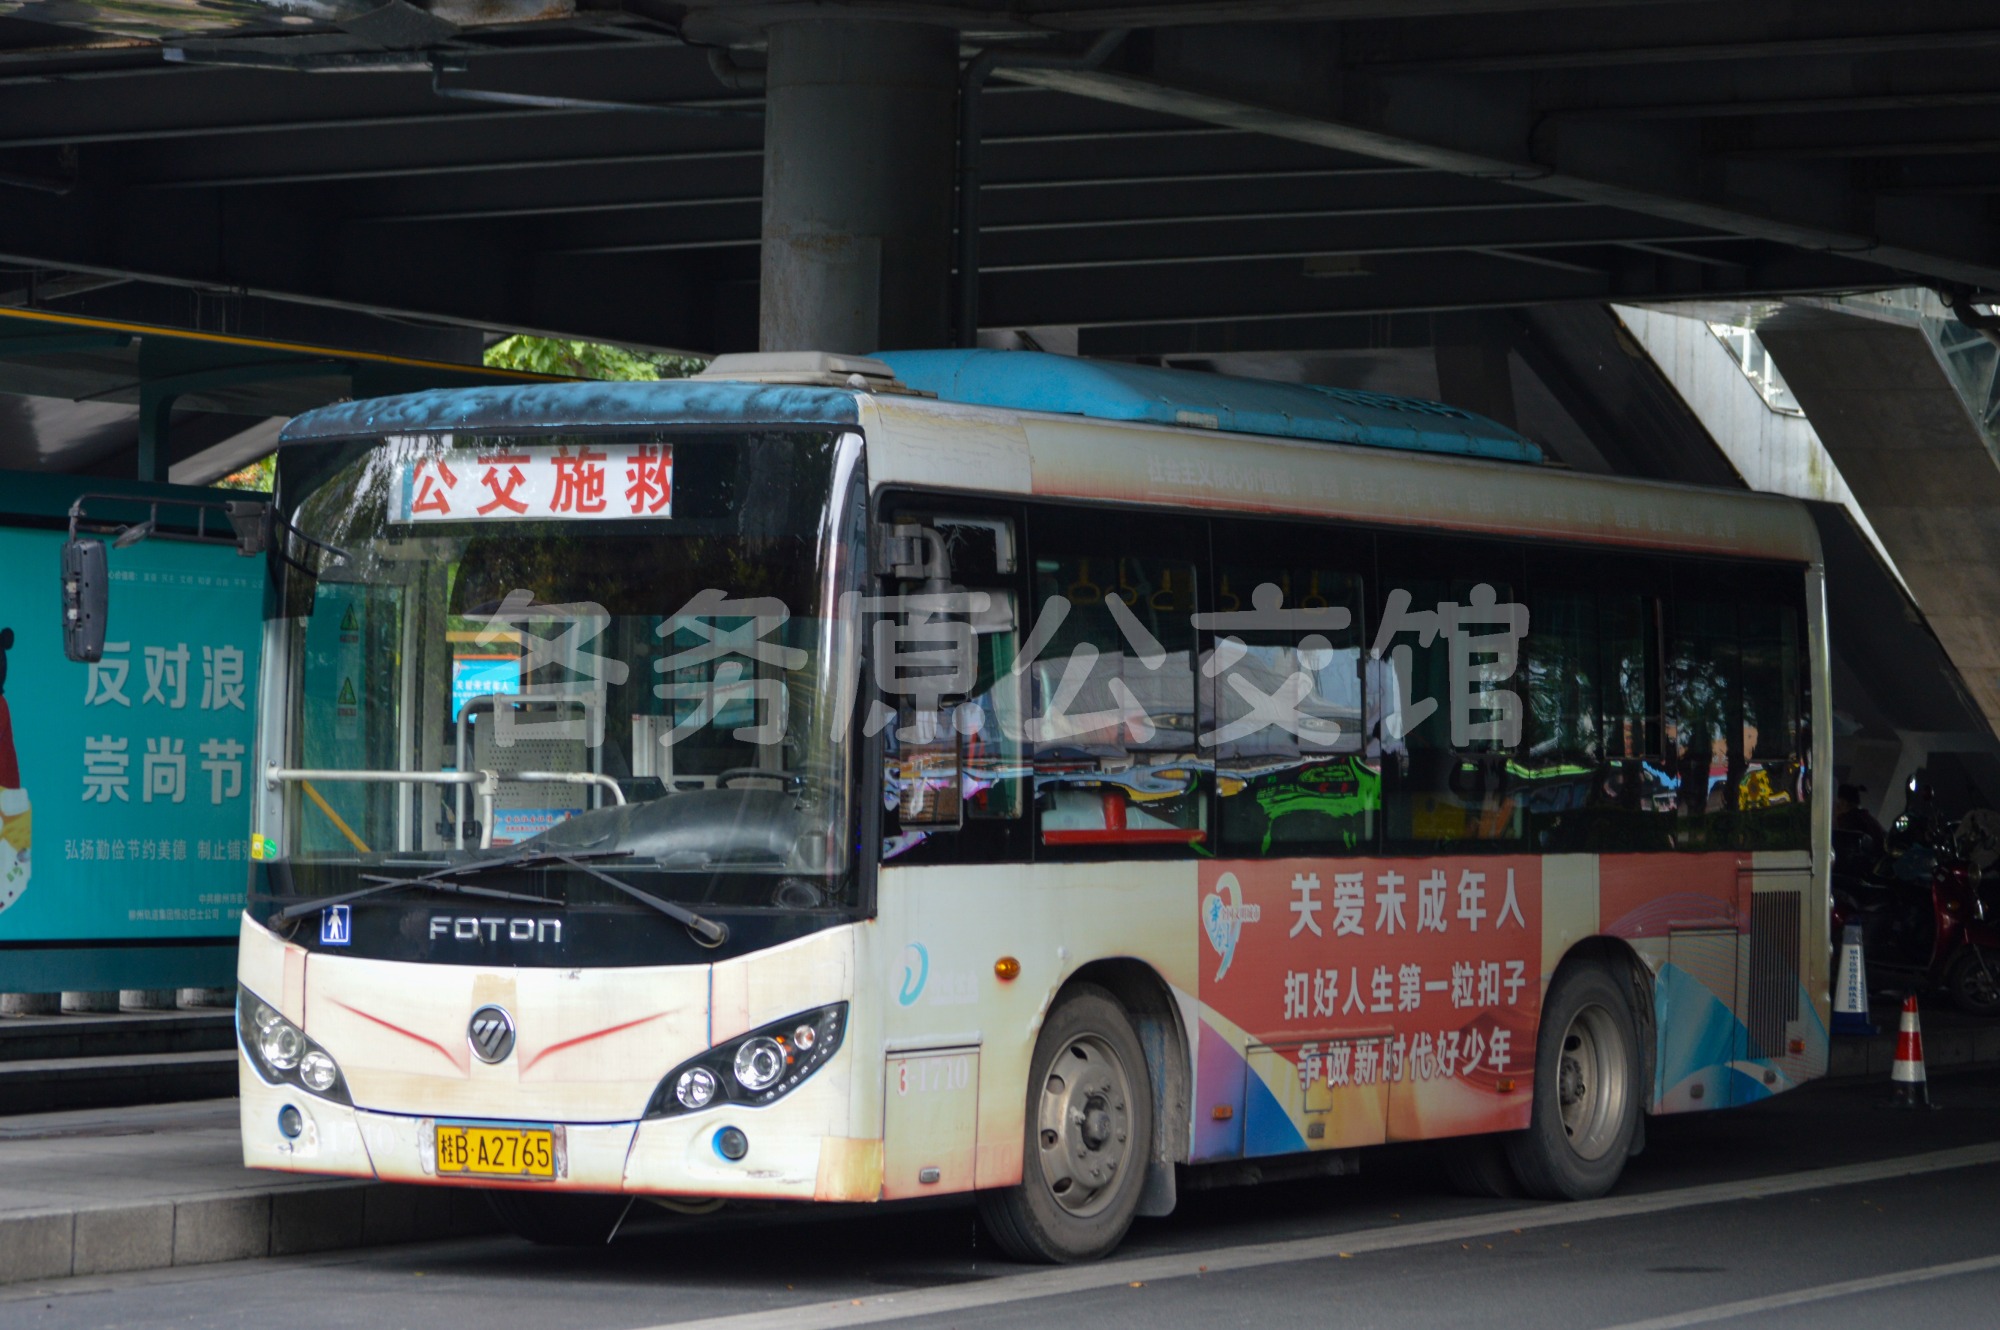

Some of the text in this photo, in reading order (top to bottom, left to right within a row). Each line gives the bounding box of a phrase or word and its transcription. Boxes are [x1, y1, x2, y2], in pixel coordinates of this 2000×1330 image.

[411, 444, 672, 515] 公交施救
[82, 734, 245, 805] 崇尚节
[429, 916, 562, 944] FOTON
[1289, 868, 1525, 939] 关爱未成年人
[1284, 960, 1526, 1020] 扣好人生第一粒扣子
[1297, 1026, 1511, 1090] 争做新时代好少年
